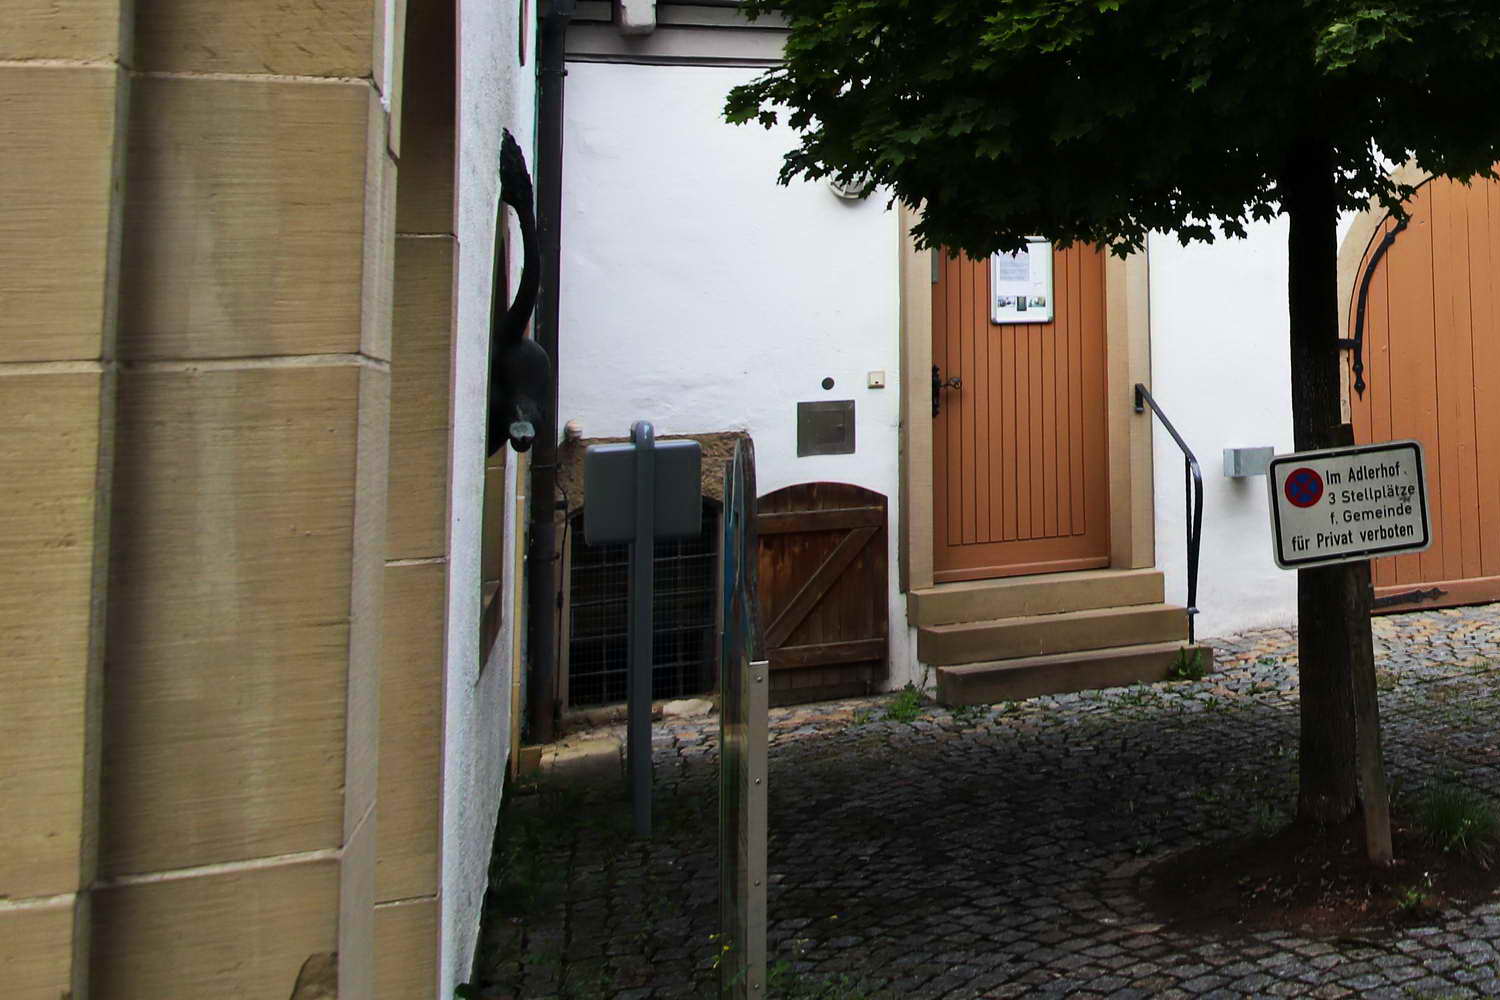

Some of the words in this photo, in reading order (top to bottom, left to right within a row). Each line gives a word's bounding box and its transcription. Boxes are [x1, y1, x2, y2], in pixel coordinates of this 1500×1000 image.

[1326, 470, 1341, 485] Im
[1348, 461, 1400, 482] Adlerhof
[1328, 493, 1336, 505] 3
[1342, 484, 1415, 503] Stellplätze
[1330, 512, 1338, 525] f.
[1343, 503, 1412, 522] Gemeinde
[1292, 536, 1310, 552] für
[1316, 530, 1353, 548] Privat
[1360, 524, 1414, 542] verboten
